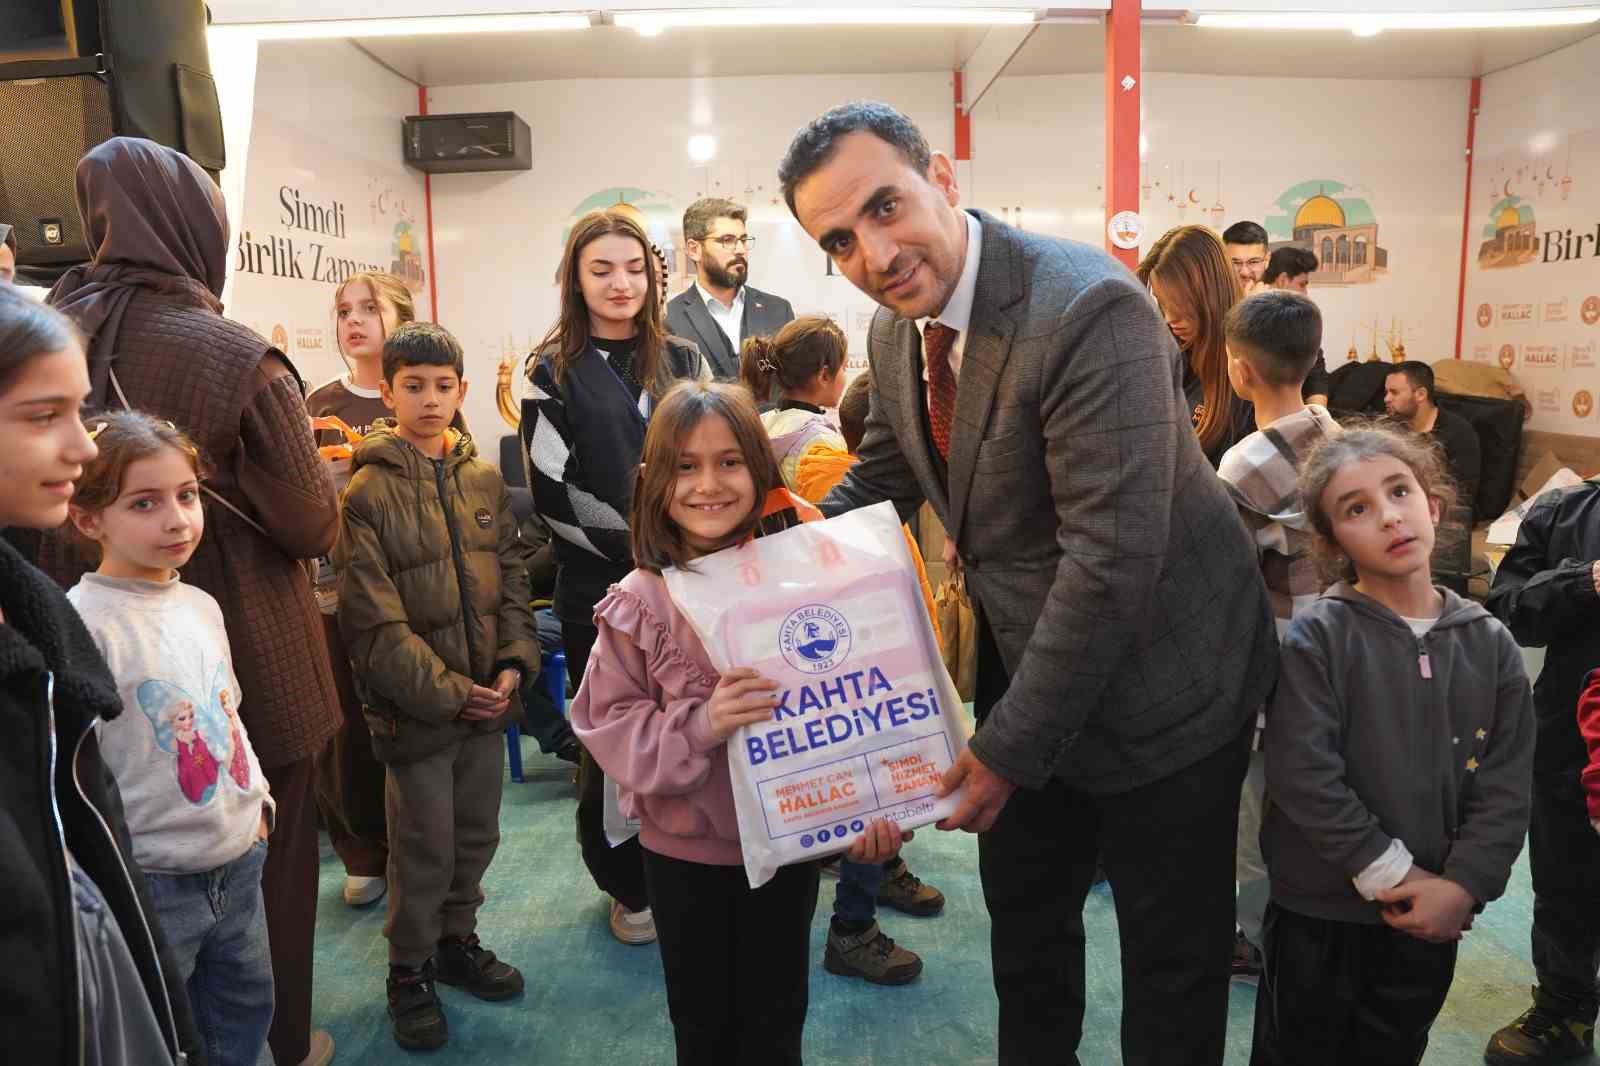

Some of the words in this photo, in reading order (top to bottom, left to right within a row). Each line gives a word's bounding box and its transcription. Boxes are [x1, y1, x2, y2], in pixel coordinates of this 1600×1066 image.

[280, 186, 346, 239] Şimdi
[309, 243, 385, 285] Zam
[811, 659, 835, 672] 1923
[771, 666, 893, 722] KAHTA
